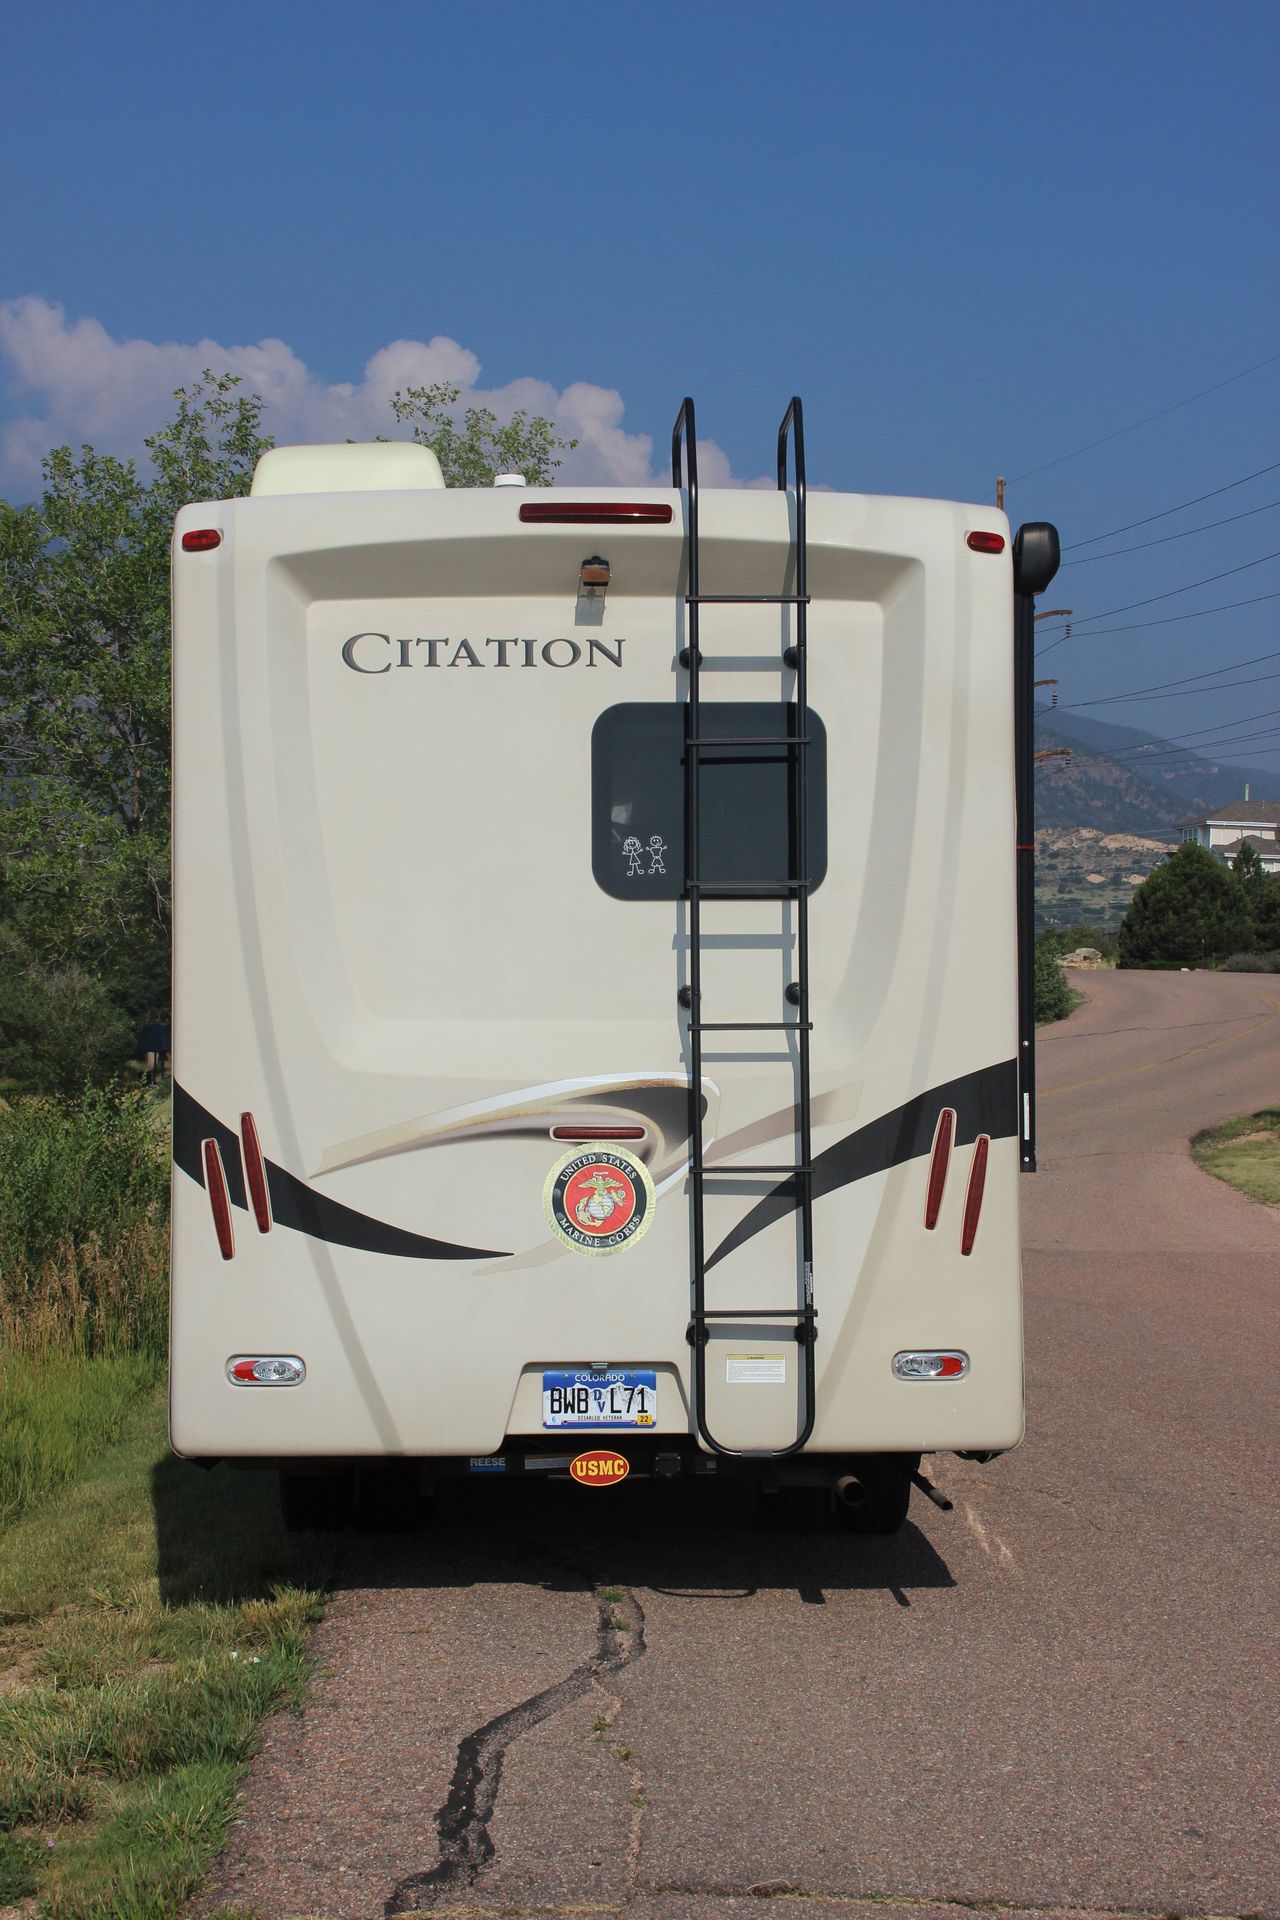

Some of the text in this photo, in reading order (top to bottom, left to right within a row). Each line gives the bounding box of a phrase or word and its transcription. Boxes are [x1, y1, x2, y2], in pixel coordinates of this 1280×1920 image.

[341, 632, 627, 674] CITATION
[560, 1154, 637, 1181] UNITED STATES
[560, 1216, 641, 1247] MARINE CORPS
[574, 1373, 626, 1382] COLORADO
[639, 1415, 649, 1423] 22
[469, 1457, 506, 1467] REESE
[575, 1459, 625, 1477] USMC
